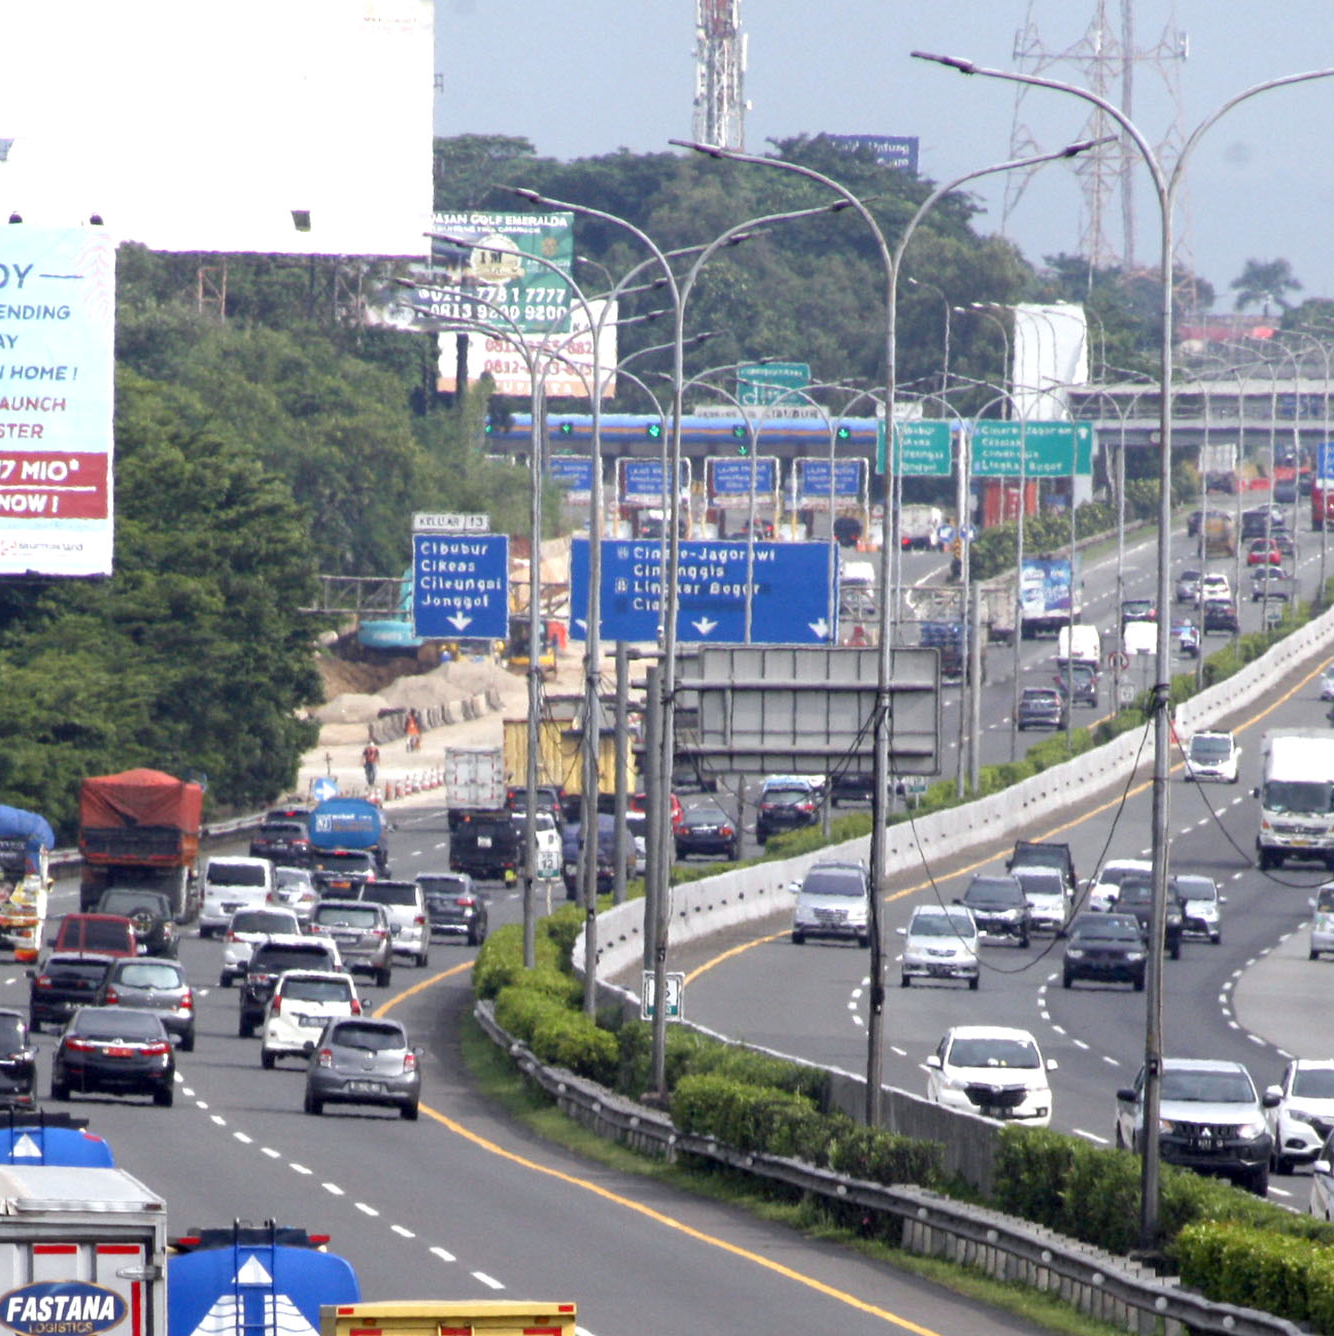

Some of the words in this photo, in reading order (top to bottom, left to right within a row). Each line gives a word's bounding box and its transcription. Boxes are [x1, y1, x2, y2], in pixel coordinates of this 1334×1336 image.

[470, 214, 502, 226] GOLF
[505, 215, 568, 227] EMERALDA
[526, 288, 565, 304] 7777
[10, 365, 68, 382] HOME
[419, 517, 460, 527] KELUAR
[420, 542, 488, 555] Cibubur
[421, 560, 475, 573] Cikeas
[420, 576, 502, 593] Cileungsi
[421, 593, 490, 610] Jonggol
[633, 597, 680, 611] Ciai
[5, 1295, 115, 1322] FASTANA
[29, 1322, 94, 1333] LOGISTICS
